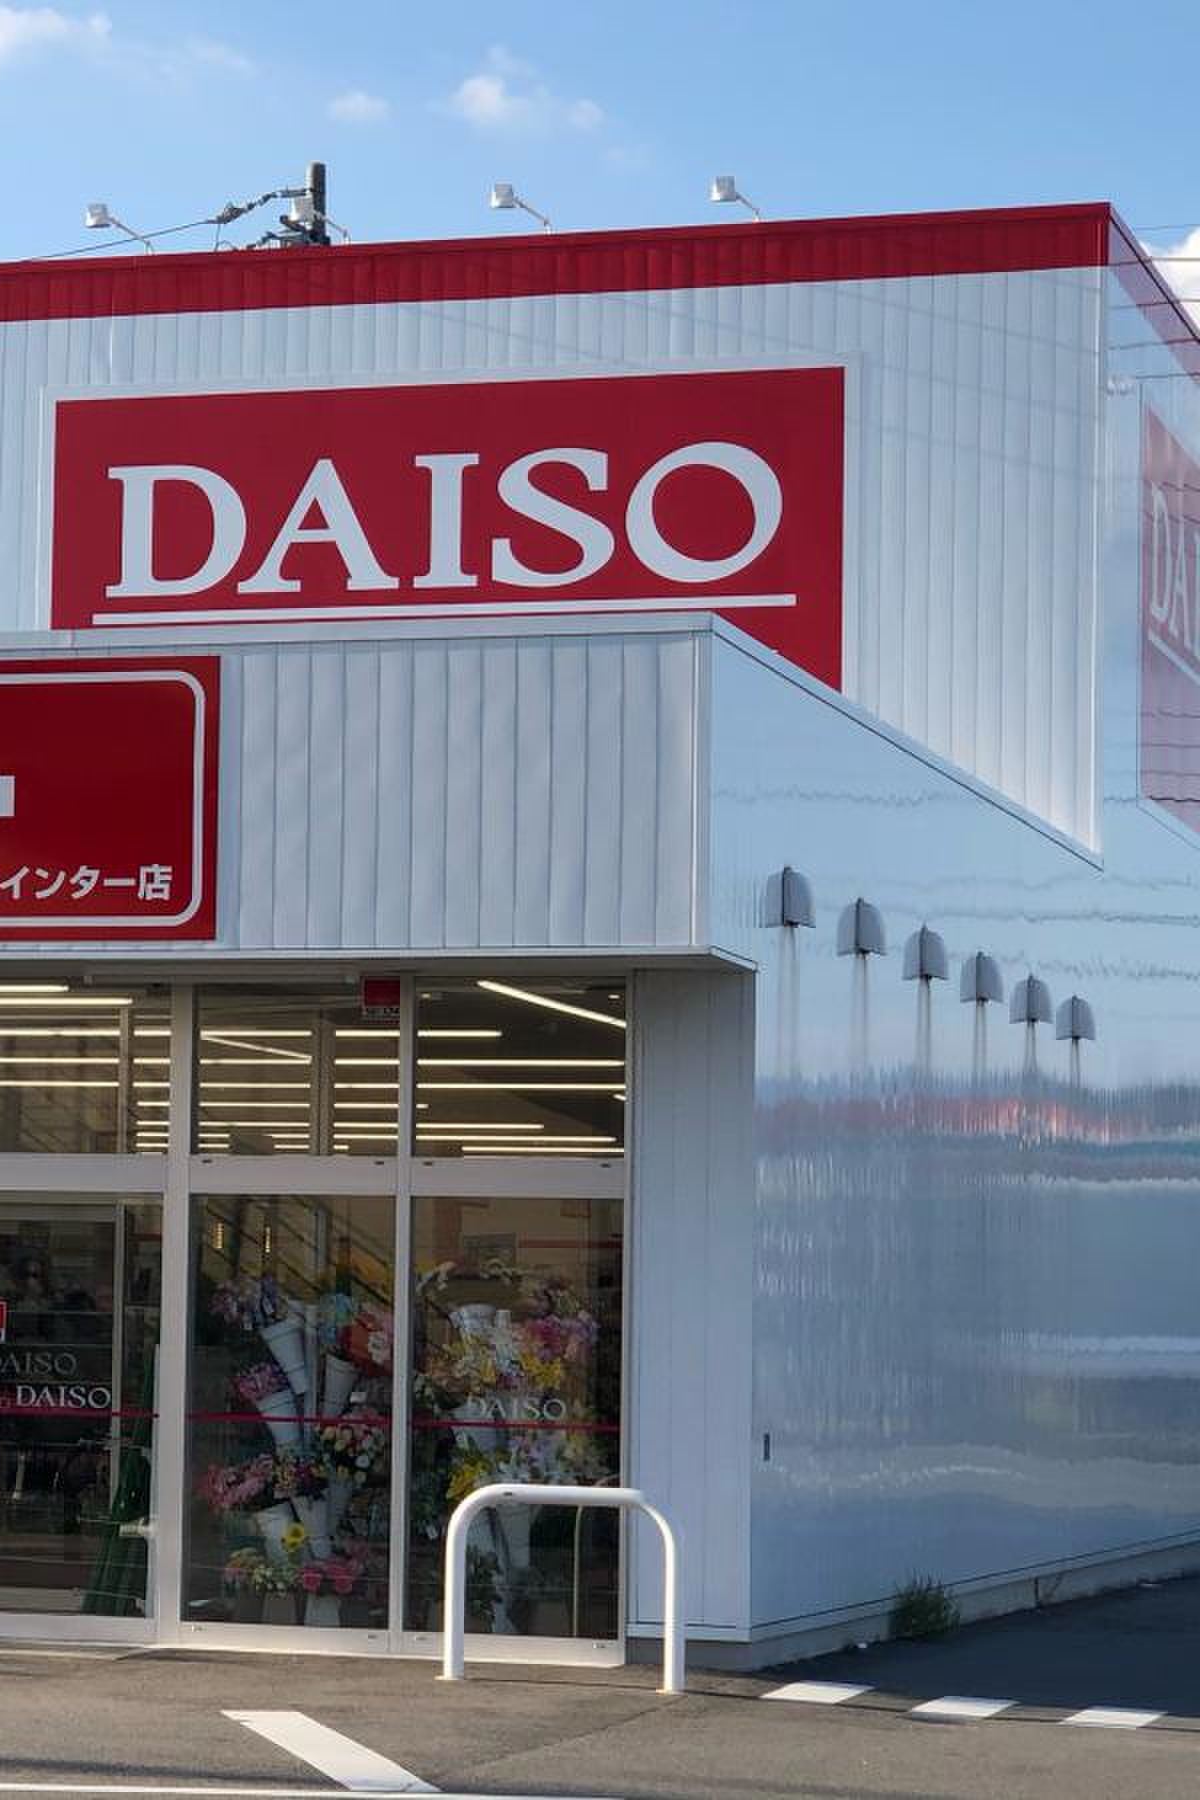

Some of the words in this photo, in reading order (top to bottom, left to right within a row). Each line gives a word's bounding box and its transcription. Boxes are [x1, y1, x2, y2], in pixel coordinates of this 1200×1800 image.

[105, 441, 783, 598] DAISO
[16, 1385, 111, 1409] DAISO
[465, 1395, 566, 1421] DAISO
